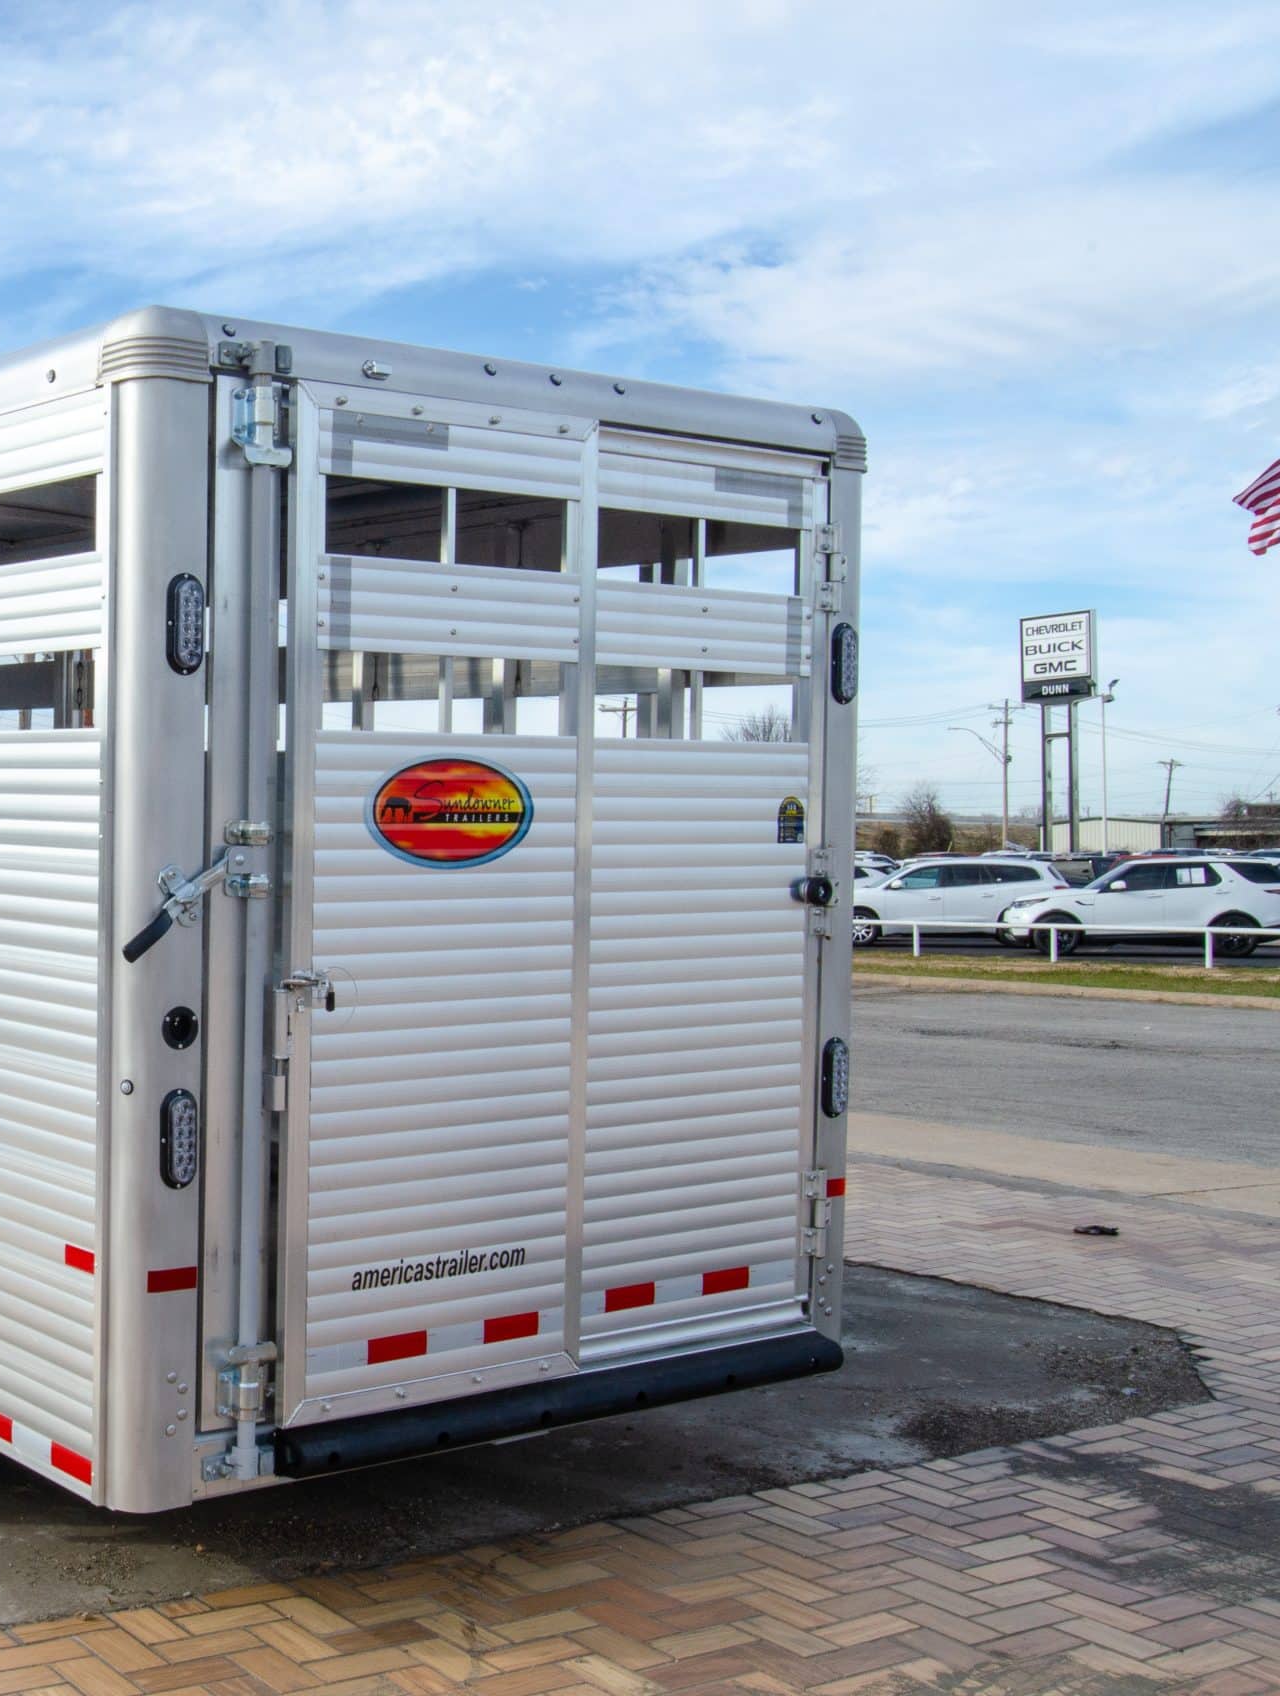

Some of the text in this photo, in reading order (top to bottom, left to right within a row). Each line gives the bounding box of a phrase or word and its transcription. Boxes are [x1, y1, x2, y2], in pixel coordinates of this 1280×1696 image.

[1025, 621, 1083, 636] CHEVROLET
[1025, 640, 1084, 656] BUICK
[1033, 660, 1077, 674] GMC
[1041, 684, 1070, 695] DUNN
[414, 780, 515, 820] Sundowner
[445, 813, 510, 822] TRAILERS
[351, 1246, 526, 1292] americastrailer.com
